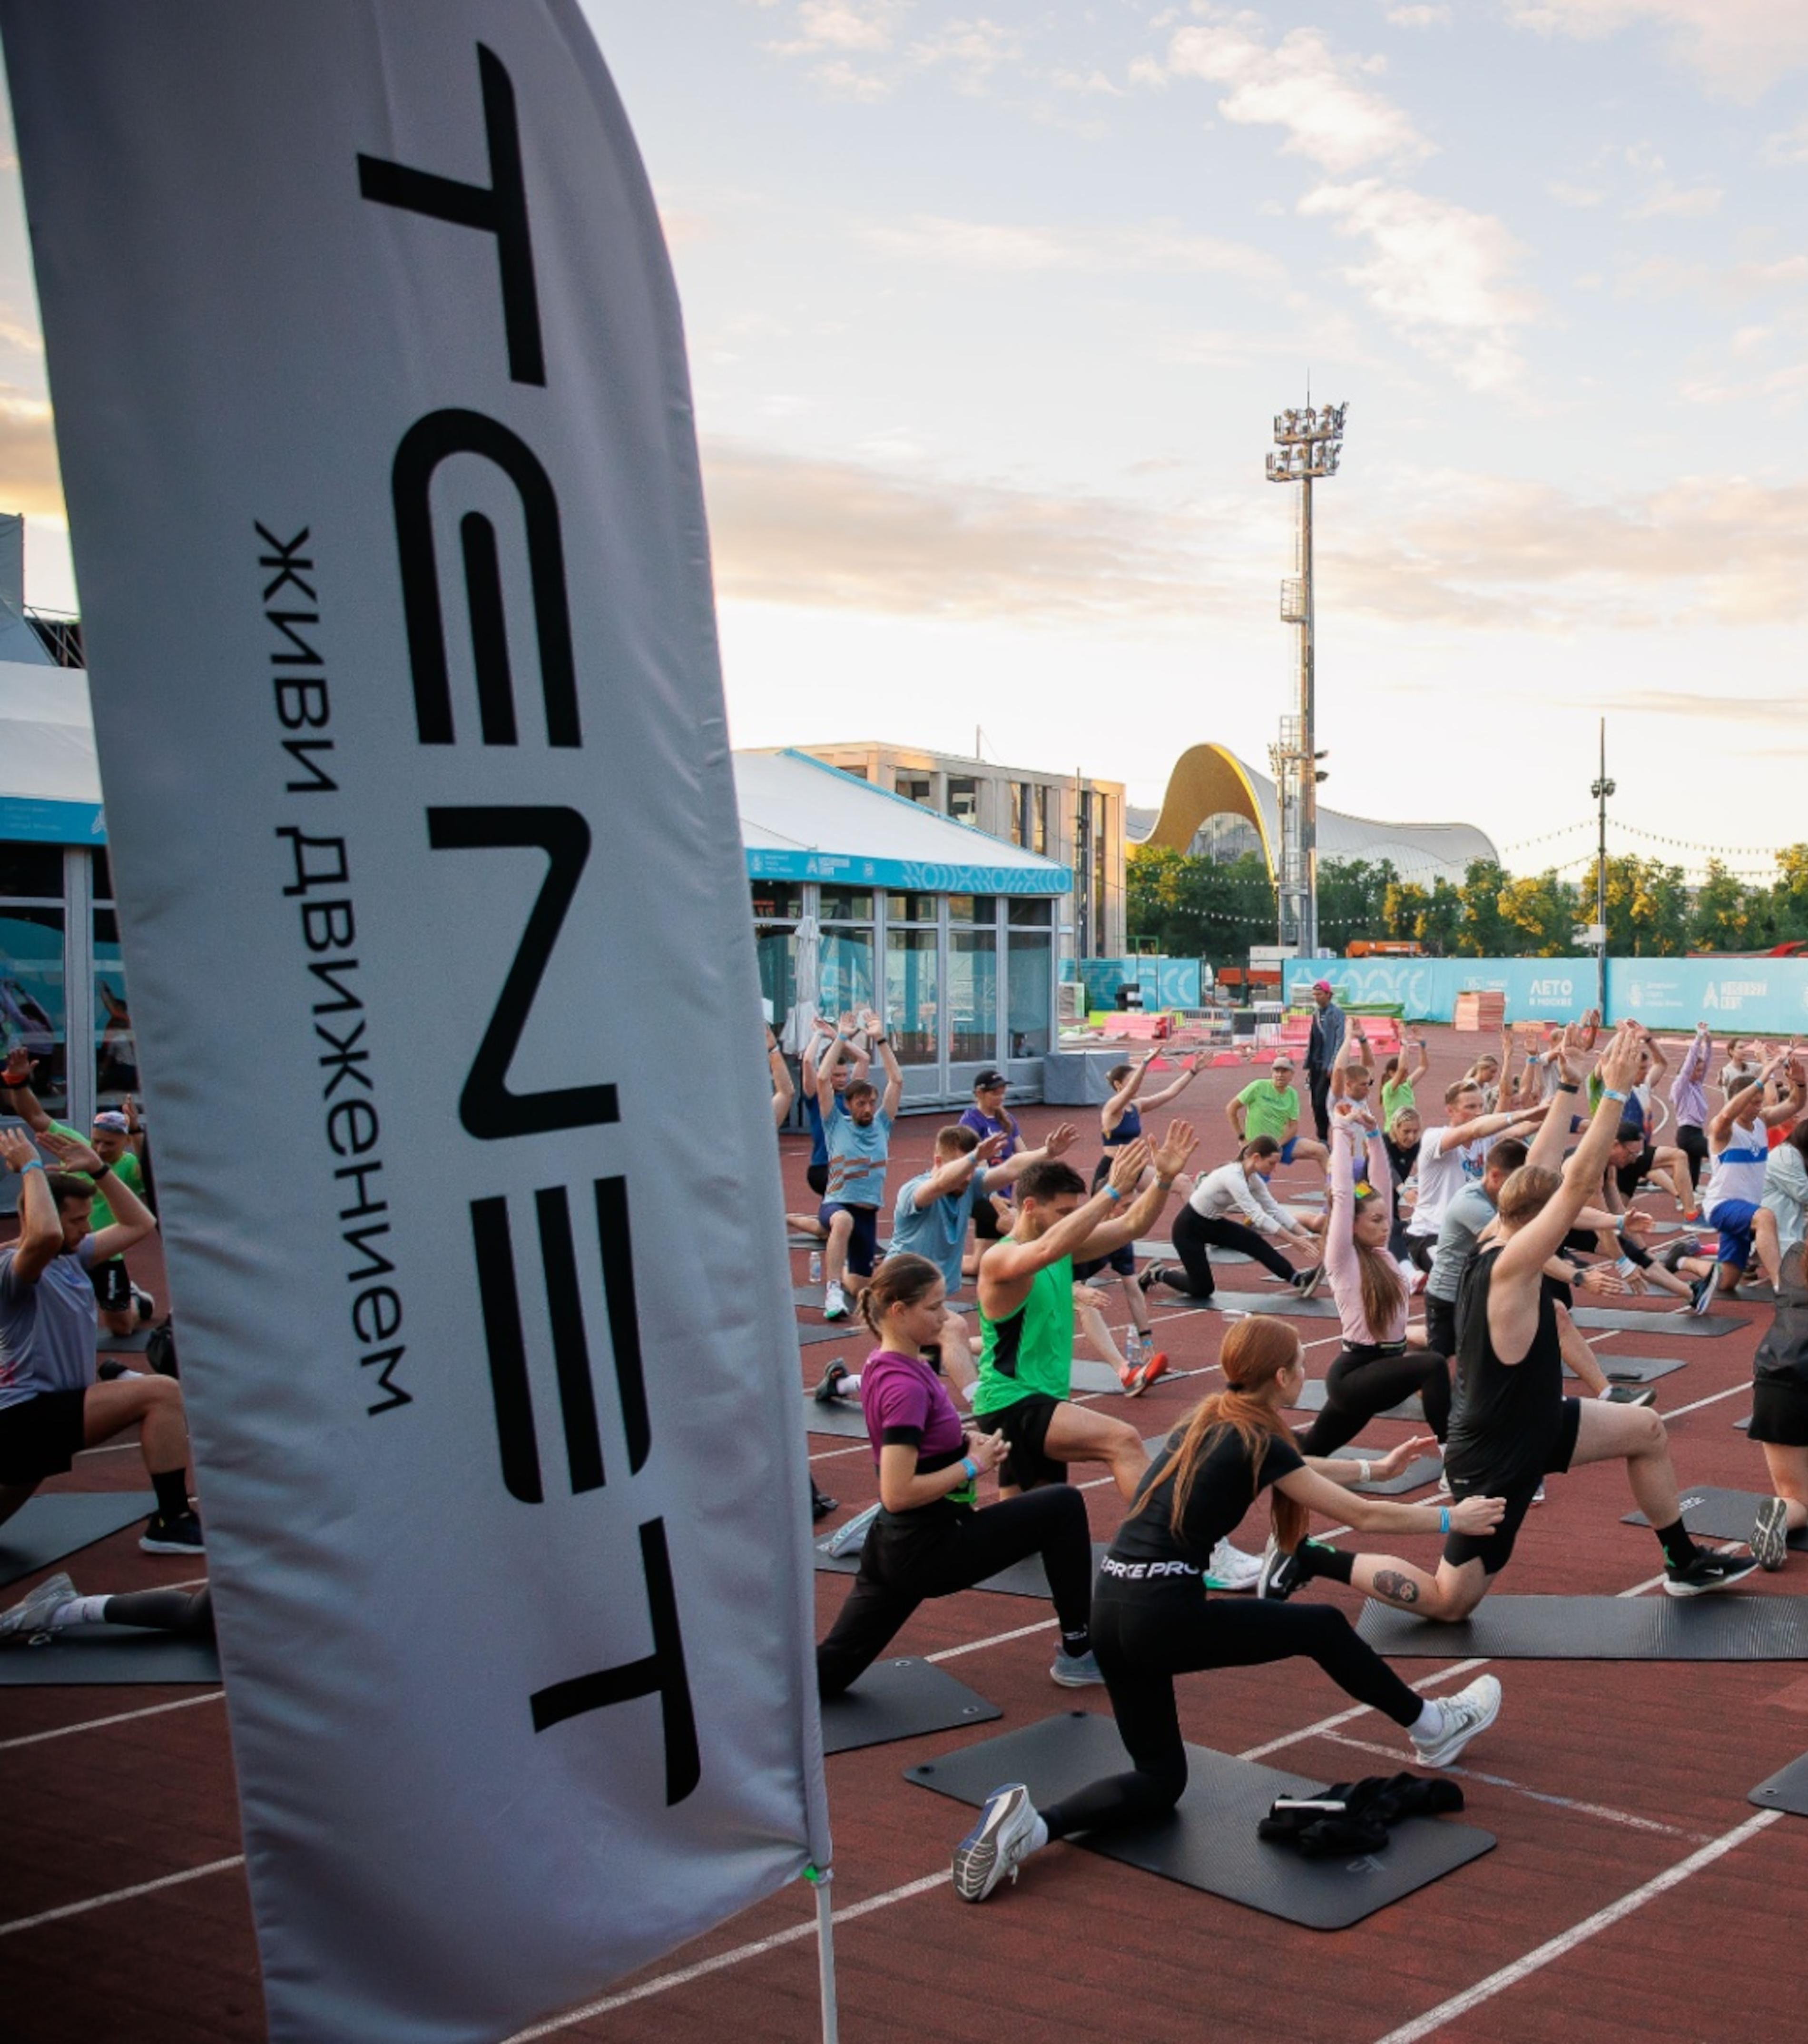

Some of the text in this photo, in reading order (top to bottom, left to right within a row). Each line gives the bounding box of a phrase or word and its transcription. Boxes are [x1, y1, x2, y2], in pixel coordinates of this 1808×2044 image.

[275, 826, 413, 1417] движением
[354, 41, 702, 1808] TENET
[1530, 979, 1573, 996] ЛЕТО
